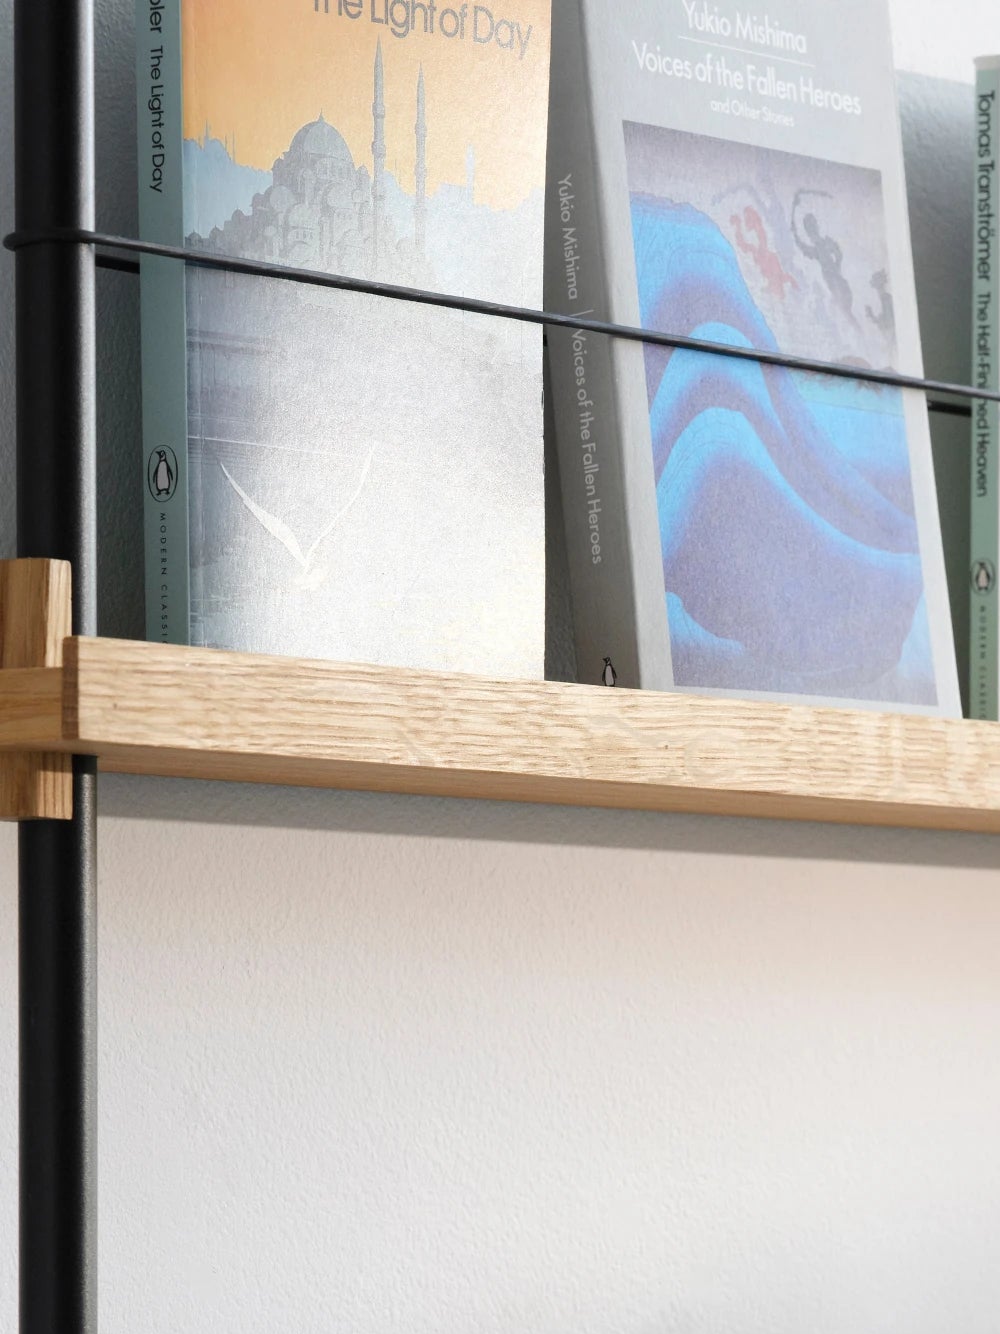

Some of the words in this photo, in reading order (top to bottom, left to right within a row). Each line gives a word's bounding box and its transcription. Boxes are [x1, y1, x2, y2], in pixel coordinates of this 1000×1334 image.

[439, 3, 468, 40] of
[473, 5, 533, 60] Day
[682, 0, 731, 37] Yukio
[735, 12, 807, 54] Mishima
[150, 45, 163, 80] The
[631, 38, 692, 80] Voices
[694, 52, 714, 84] of
[715, 56, 744, 91] the
[746, 63, 798, 103] Fallen
[800, 76, 862, 116] Heroes
[147, 84, 165, 128] Light
[709, 99, 730, 115] and
[731, 100, 762, 121] Other
[762, 105, 796, 128] Stories
[977, 90, 996, 159] Tomas
[151, 130, 165, 149] of
[149, 154, 165, 194] Day
[557, 172, 573, 223] Yukio
[977, 160, 996, 282] Tranströmer
[562, 225, 578, 301] Mishima
[976, 291, 991, 322] The
[570, 326, 587, 388] Voices
[576, 386, 592, 407] of
[579, 408, 592, 441] the
[581, 441, 600, 497] Fallen
[976, 432, 991, 497] Heaven
[159, 511, 168, 576] MODERN
[586, 498, 602, 566] Heroes
